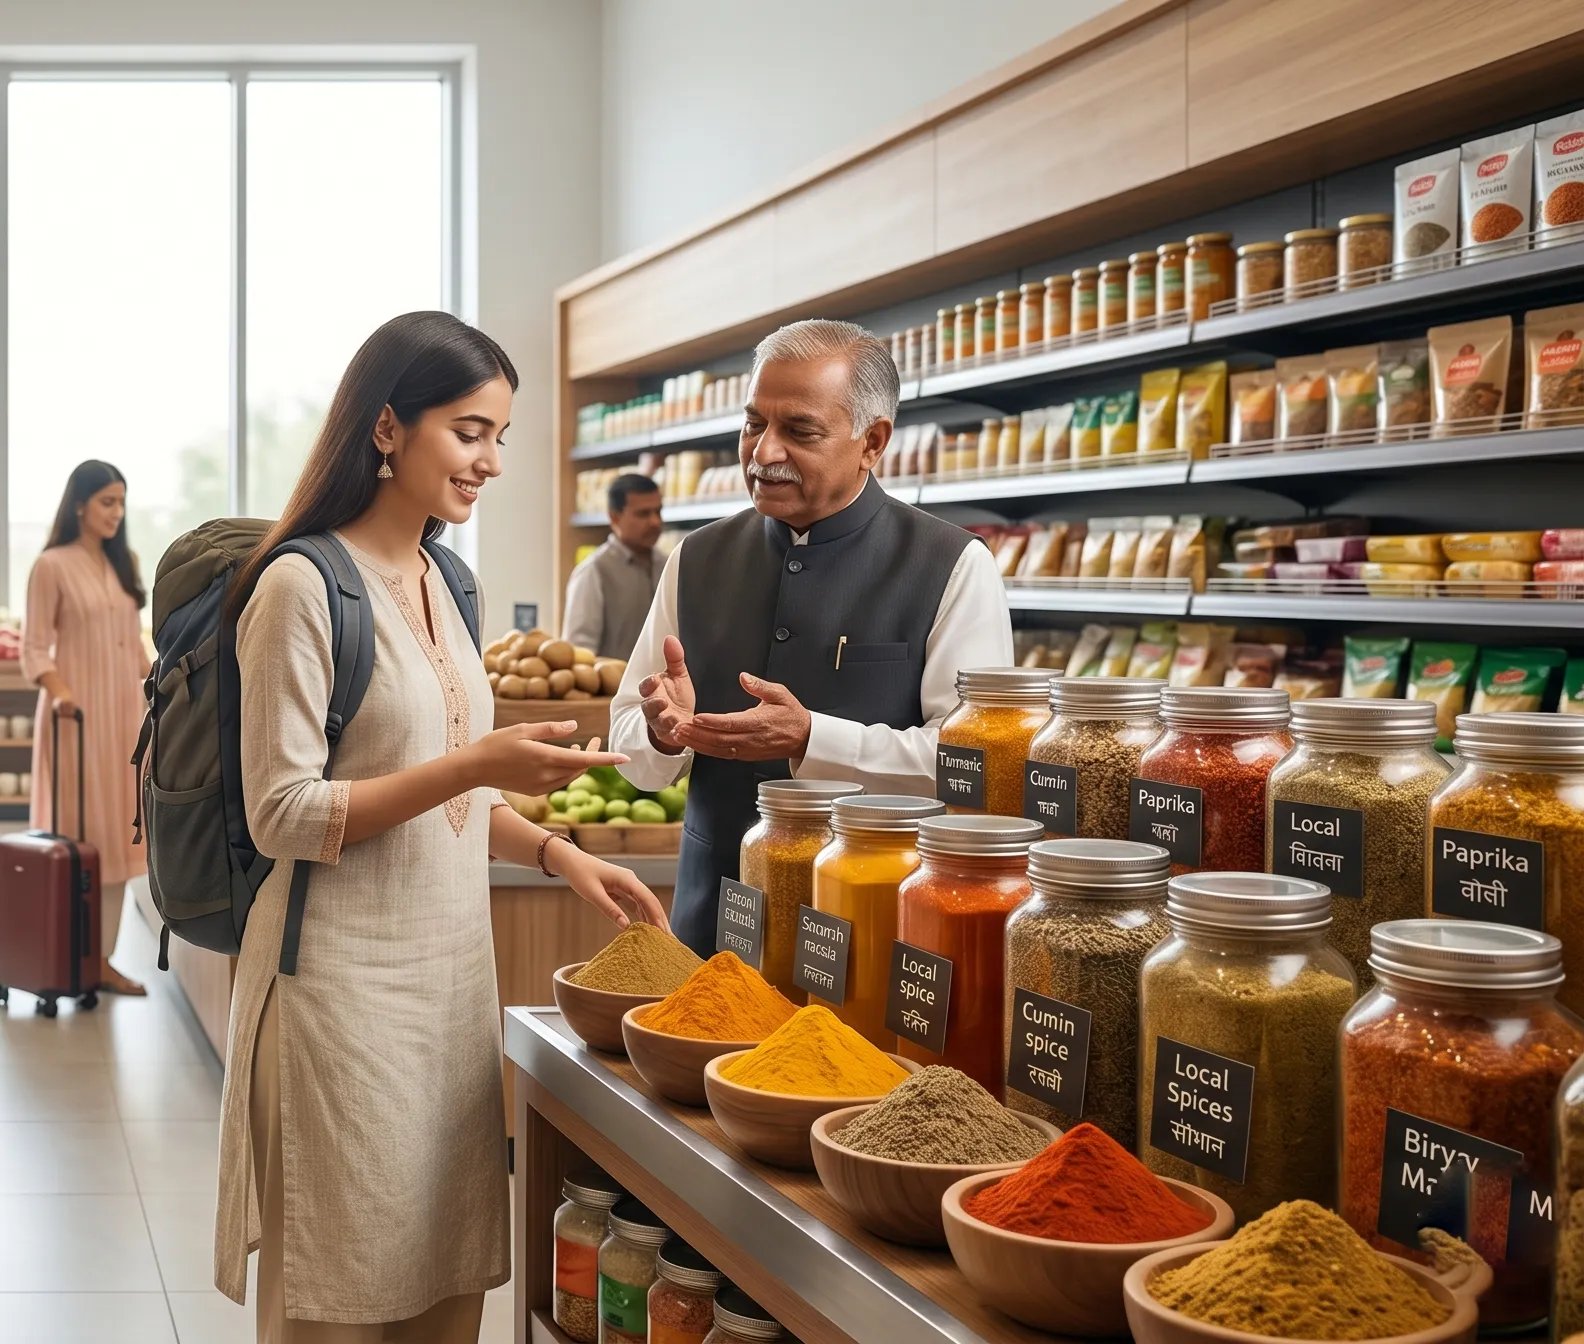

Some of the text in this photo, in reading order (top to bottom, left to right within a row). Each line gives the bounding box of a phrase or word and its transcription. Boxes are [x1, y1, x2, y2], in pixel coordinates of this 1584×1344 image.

[1030, 770, 1067, 791] Cumin
[1139, 789, 1195, 815] Paprika
[1291, 812, 1340, 837] Local
[1443, 839, 1529, 874] Paprika
[902, 953, 937, 982] Local
[899, 979, 935, 1006] spice
[1022, 1001, 1075, 1037] Cumin
[1025, 1032, 1069, 1061] spice
[1175, 1053, 1229, 1092] Local
[1167, 1081, 1233, 1123] Spices
